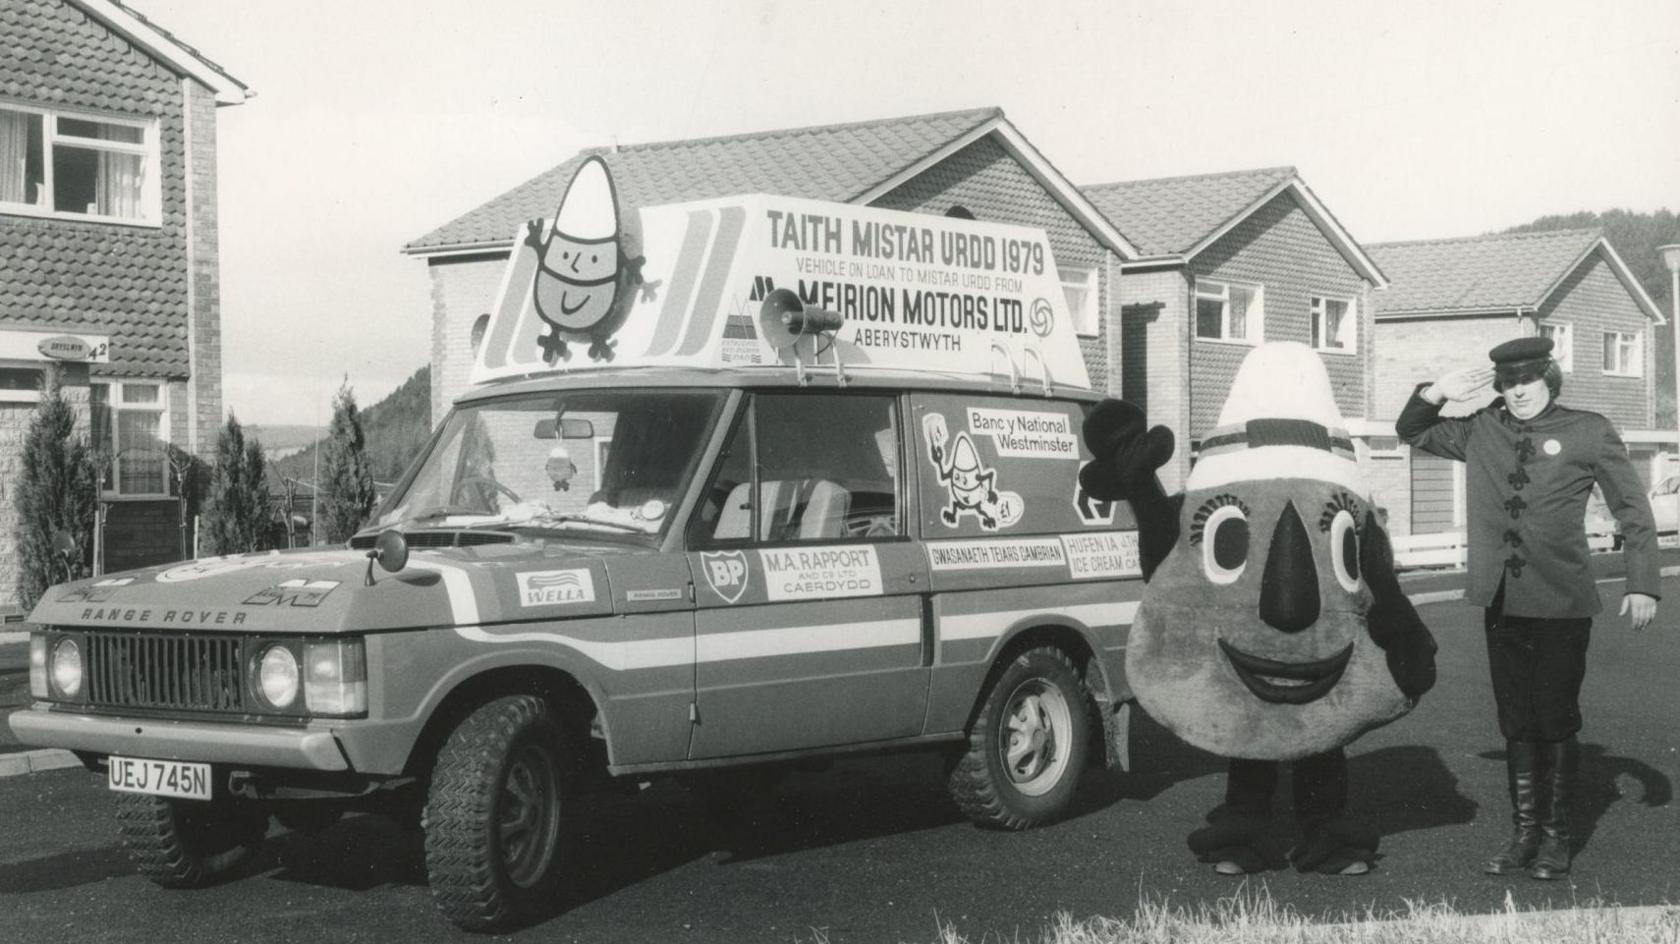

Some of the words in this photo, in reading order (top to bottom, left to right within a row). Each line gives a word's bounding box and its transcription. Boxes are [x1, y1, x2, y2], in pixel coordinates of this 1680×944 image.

[767, 209, 842, 254] TAITH
[852, 219, 934, 263] MISTAR
[941, 230, 996, 271] URDD
[1002, 238, 1044, 275] 1979
[796, 257, 845, 276] VEHICLE
[849, 262, 863, 278] ON
[866, 264, 895, 281] LOAN
[899, 266, 914, 283] TO
[917, 268, 959, 287] MISTAR
[962, 273, 991, 291] URDD
[995, 277, 1023, 294] FROM
[902, 288, 988, 331] MOTORS
[993, 297, 1028, 334] LTD.
[854, 328, 961, 351] ABERYSTWYTH
[972, 412, 1005, 430] Banc
[1006, 419, 1015, 435] y
[1017, 415, 1067, 433] National
[998, 434, 1074, 453] Westminster
[931, 546, 989, 565] GWASANAETH
[1019, 544, 1062, 562] CAMBRIAN
[1067, 536, 1105, 553] HUFEN
[709, 559, 744, 587] BP
[1072, 556, 1089, 573] ICE
[1090, 555, 1124, 571] CREAM
[784, 579, 871, 593] CAERDYDD
[799, 571, 819, 580] AND
[528, 588, 585, 603] WELLA
[81, 608, 151, 622] RANGE
[164, 610, 248, 625] ROVER
[111, 759, 148, 790] UEJ
[153, 763, 206, 796] 745N
